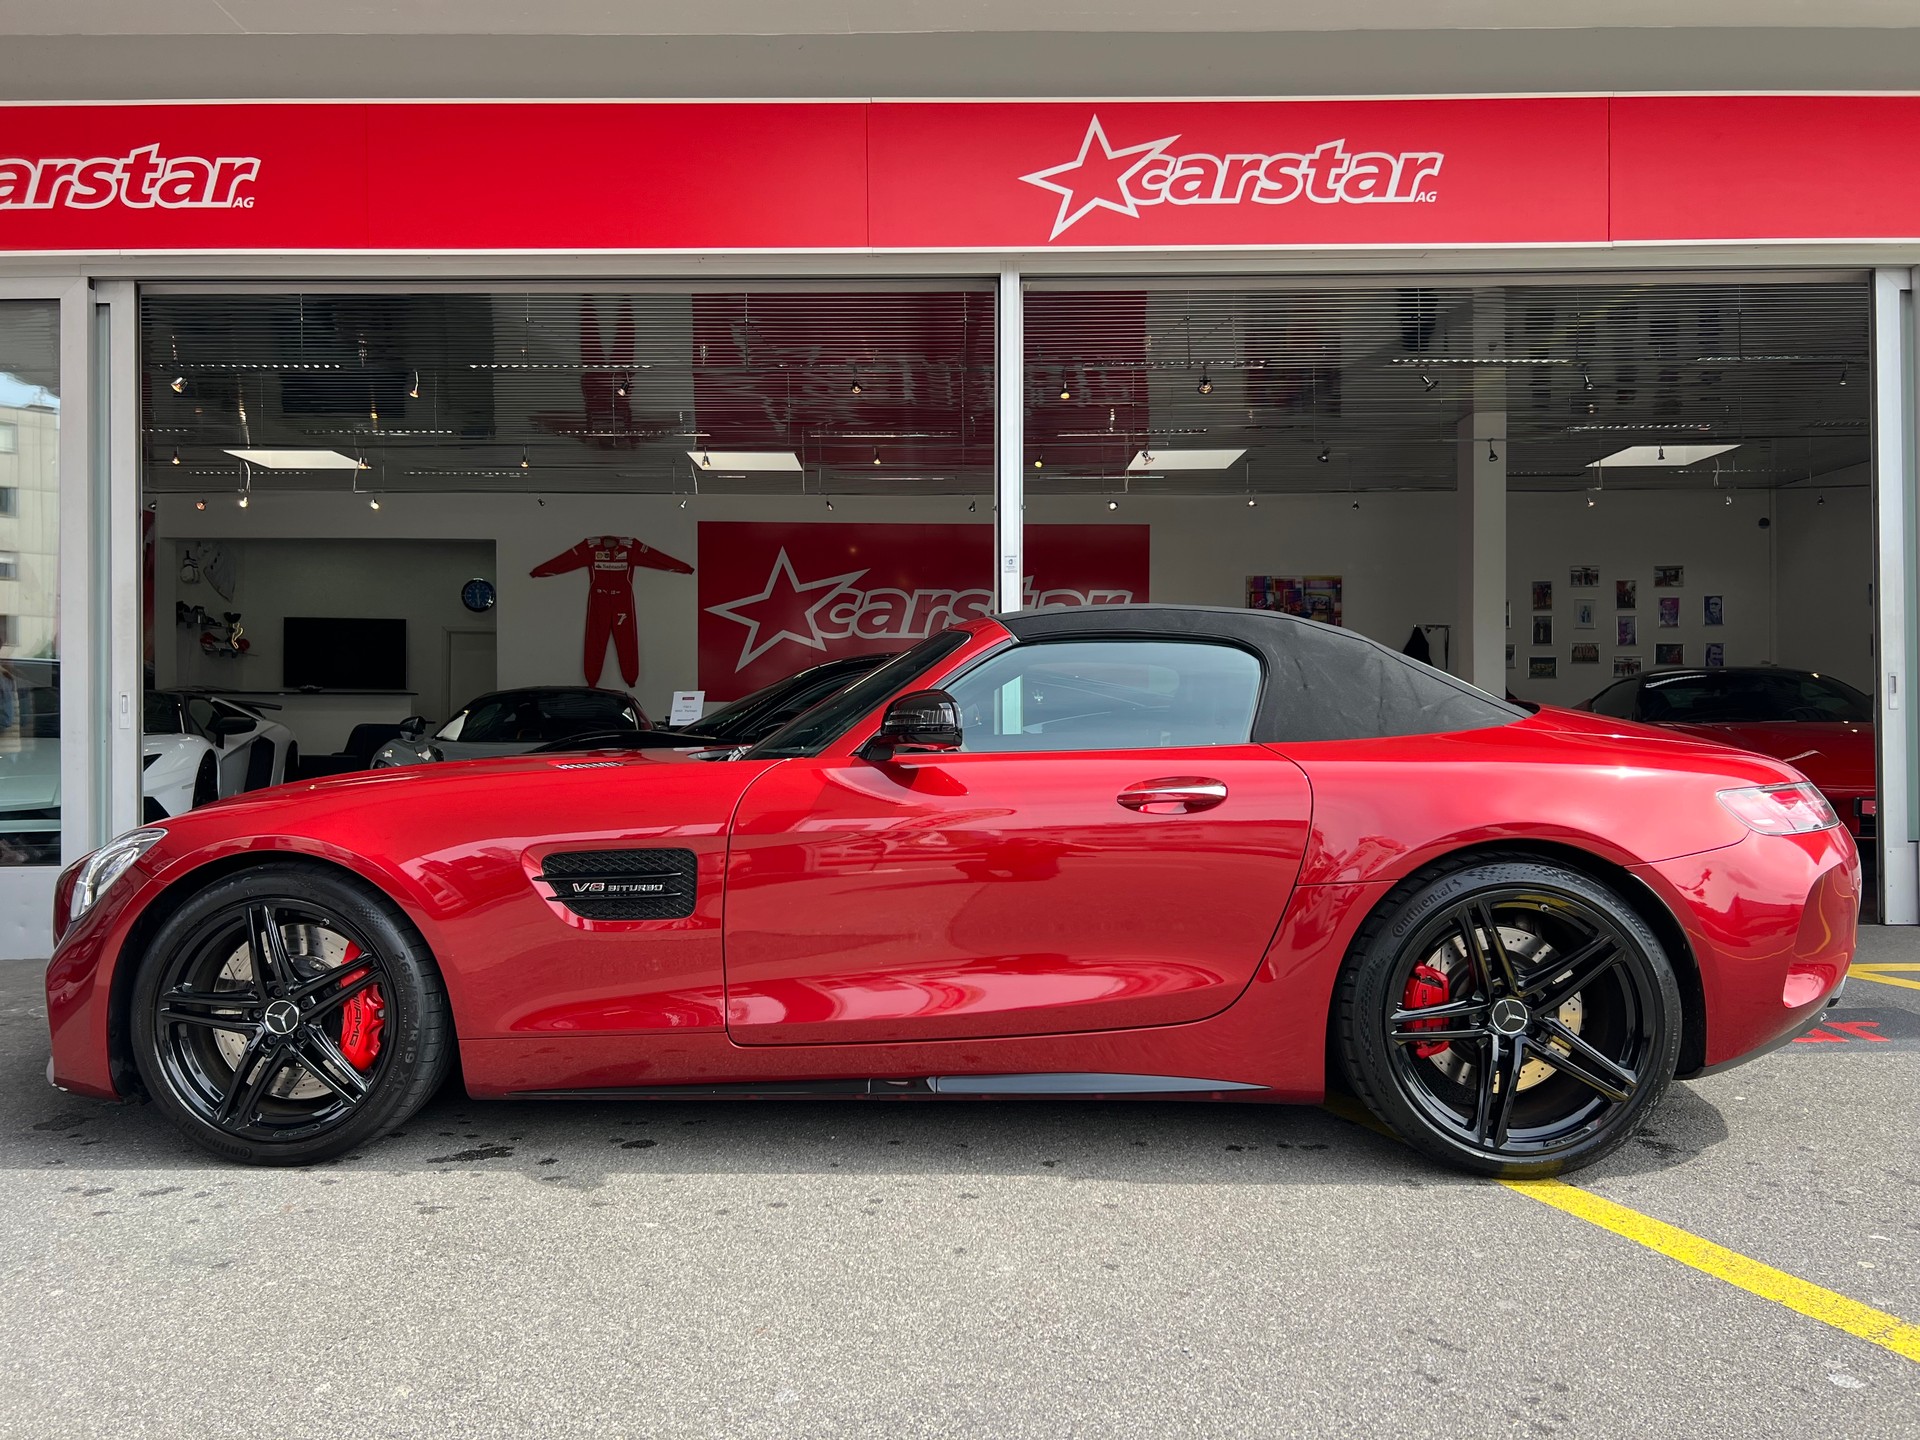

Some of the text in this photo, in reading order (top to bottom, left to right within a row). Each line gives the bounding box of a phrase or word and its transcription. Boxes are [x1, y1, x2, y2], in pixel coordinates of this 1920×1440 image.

[1126, 138, 1444, 205] carstar AG
[233, 196, 255, 208] AG
[617, 613, 627, 625] 7
[811, 575, 1134, 639] cars
[572, 882, 664, 892] V8 BITURBO
[1391, 882, 1454, 938] Continental
